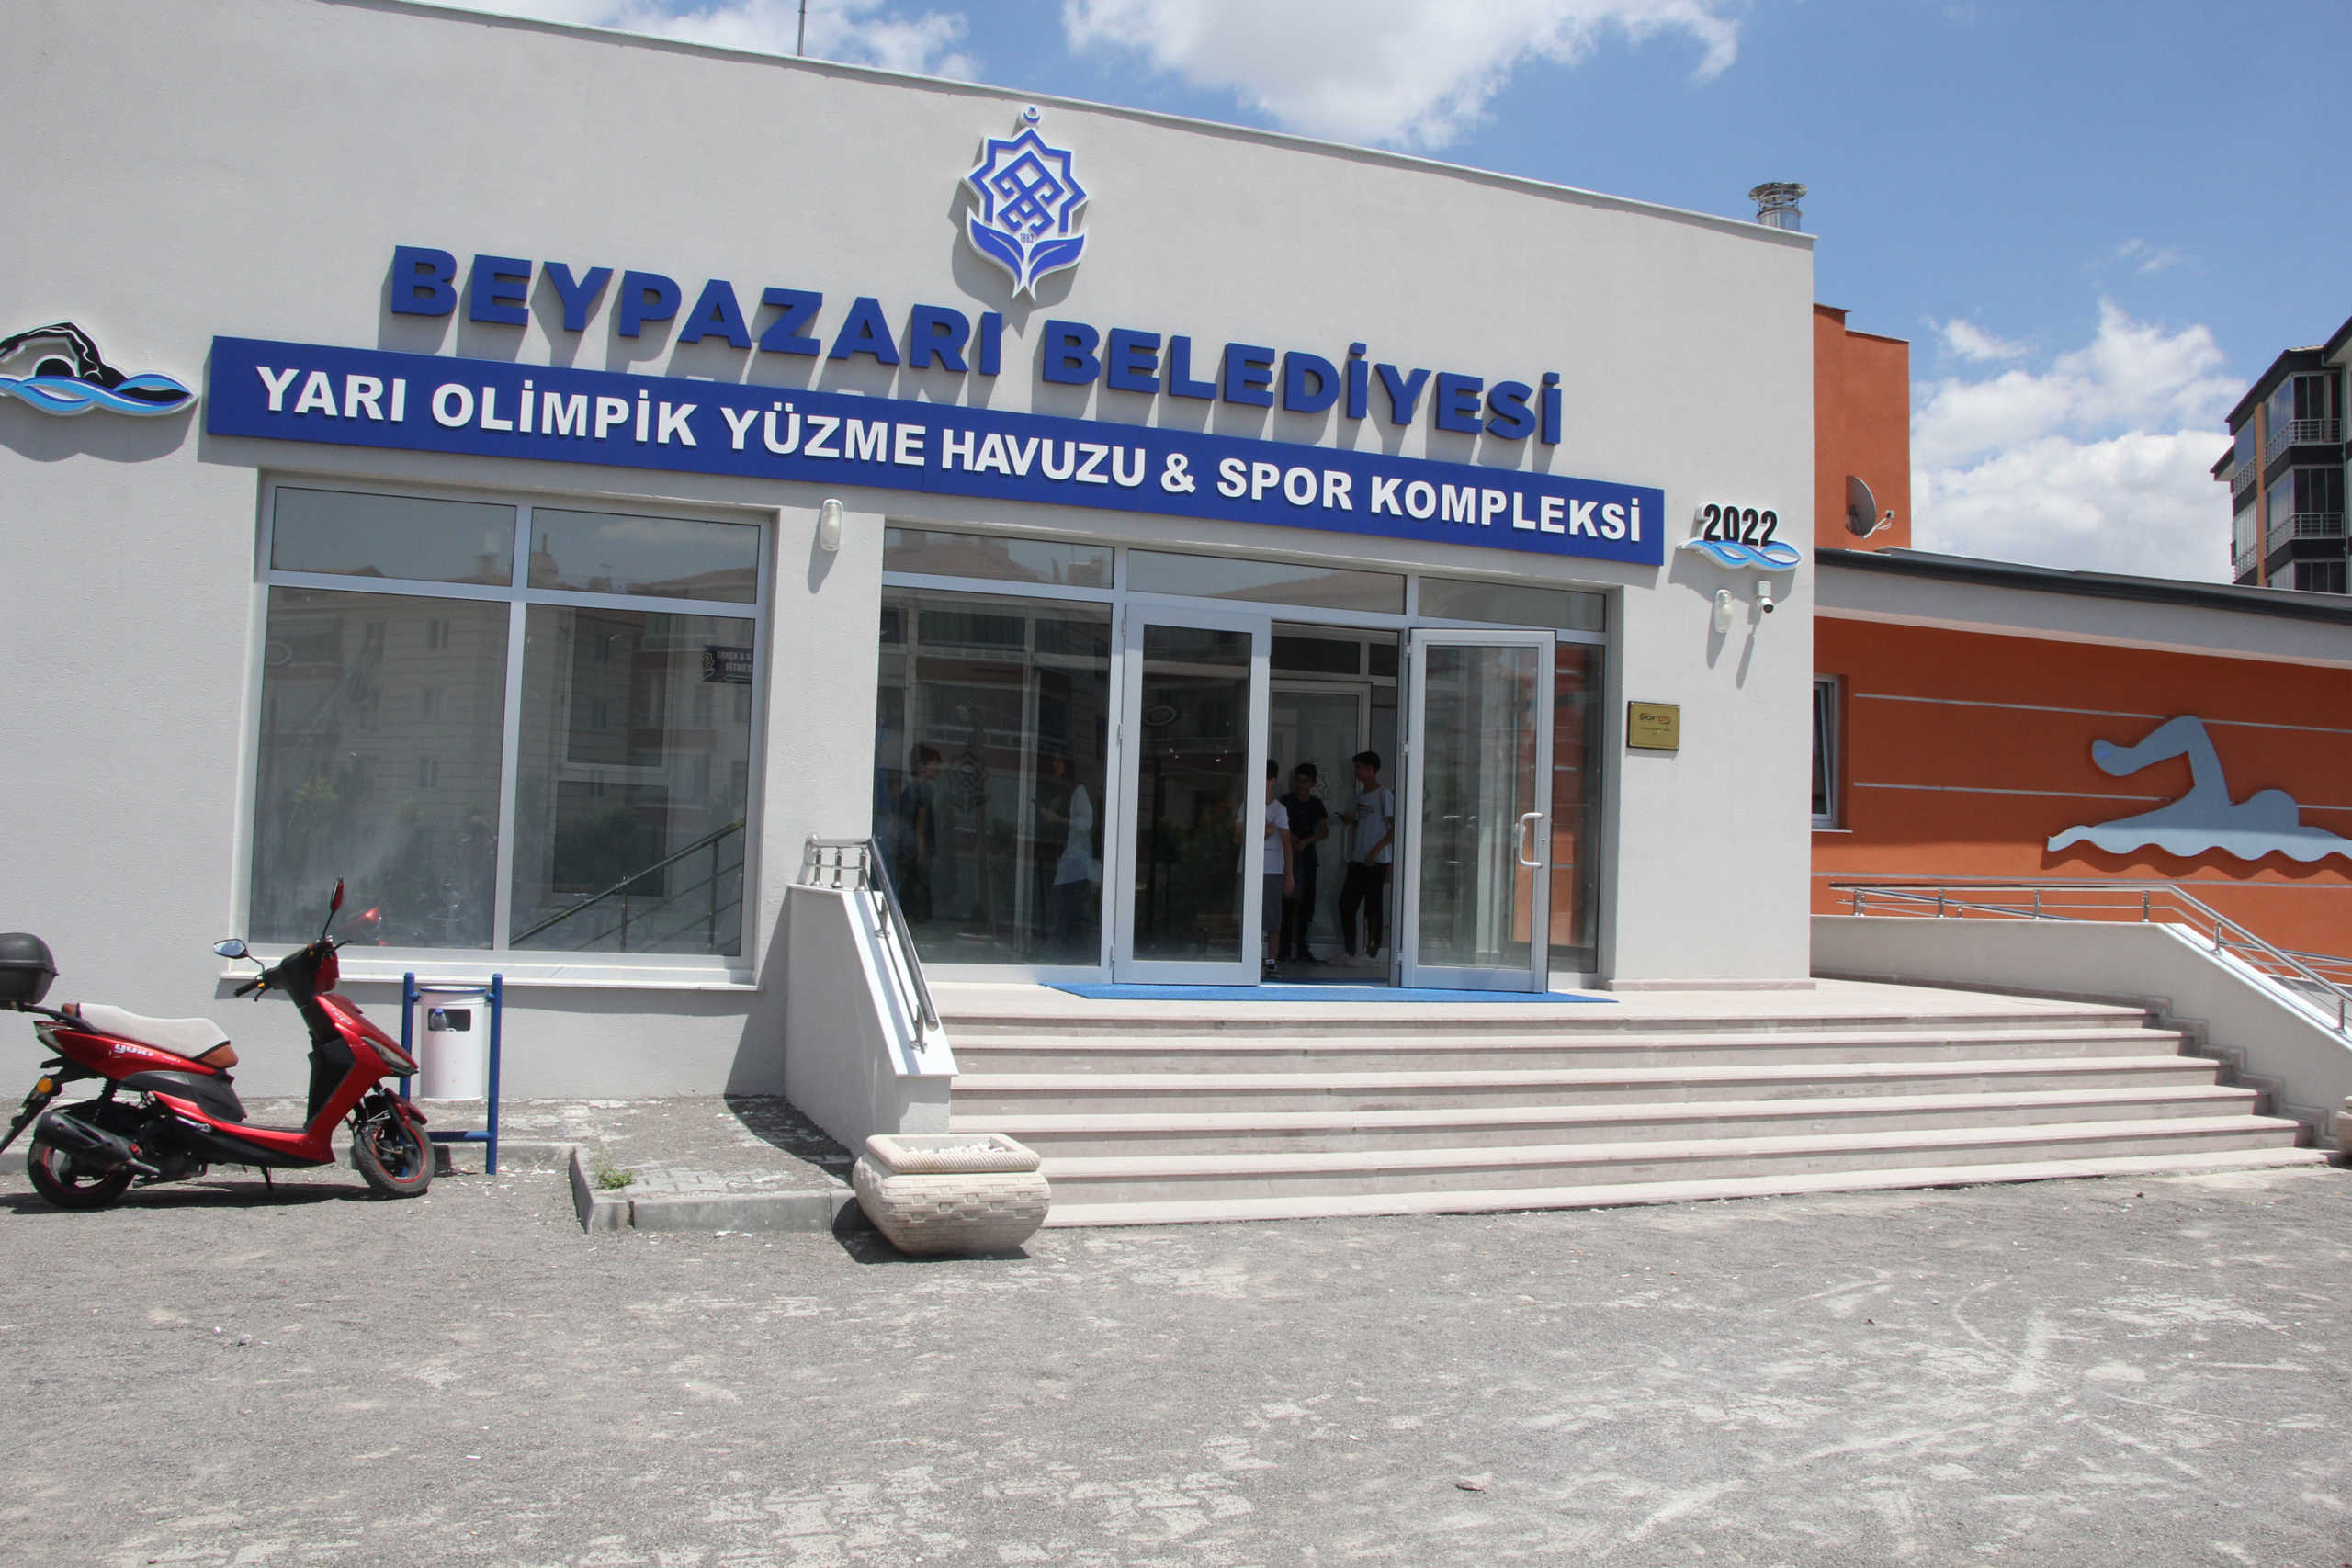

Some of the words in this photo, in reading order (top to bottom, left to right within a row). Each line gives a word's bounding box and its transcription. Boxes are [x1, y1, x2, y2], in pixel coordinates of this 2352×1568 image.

[390, 244, 1003, 375] BEYPAZARI
[1043, 318, 1562, 445] BELEDİYESİ
[255, 366, 406, 422] YARI
[432, 379, 697, 446] OLİMPİK
[720, 402, 926, 466] YÜZME
[942, 428, 1146, 487] HAVUZU
[1160, 453, 1196, 493] &
[1216, 457, 1353, 510] SPOR
[1371, 475, 1641, 542] KOMPLEKSİ
[1704, 503, 1778, 547] 2022
